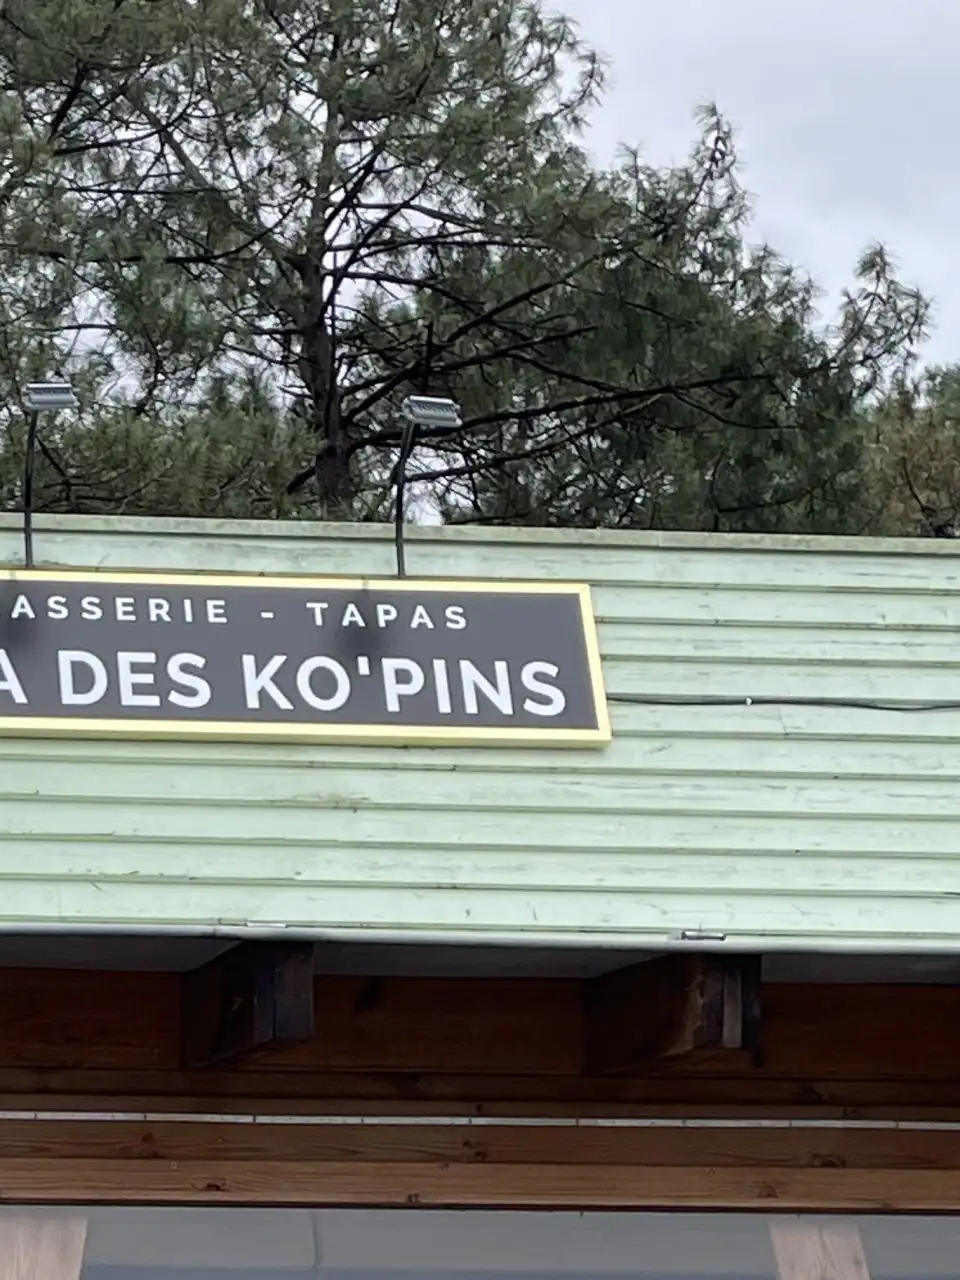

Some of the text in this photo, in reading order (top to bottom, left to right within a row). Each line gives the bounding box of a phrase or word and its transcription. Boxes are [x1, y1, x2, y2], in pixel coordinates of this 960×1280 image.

[305, 602, 468, 630] TAPAS
[57, 649, 212, 709] DES
[241, 654, 567, 718] KO'PINS
